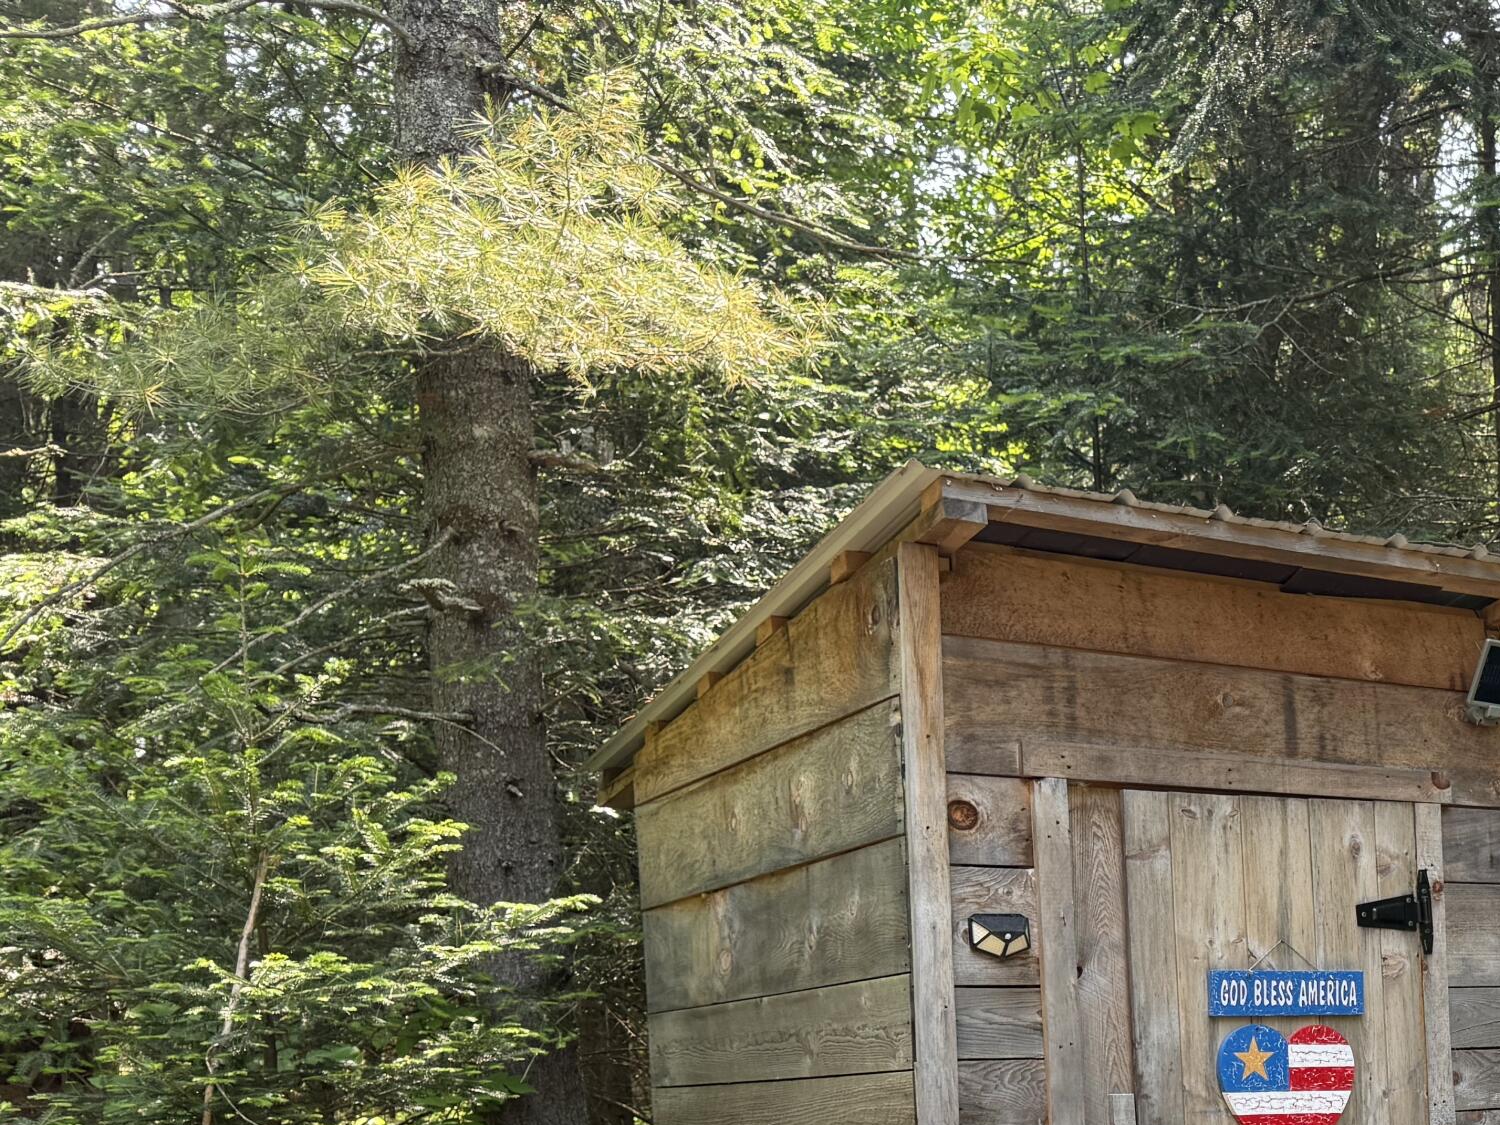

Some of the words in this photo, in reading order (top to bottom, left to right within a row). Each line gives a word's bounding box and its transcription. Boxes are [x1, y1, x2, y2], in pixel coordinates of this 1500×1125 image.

[1220, 979, 1248, 1007] GOD
[1254, 979, 1294, 1007] BLESS
[1299, 979, 1357, 1008] AMERICA
